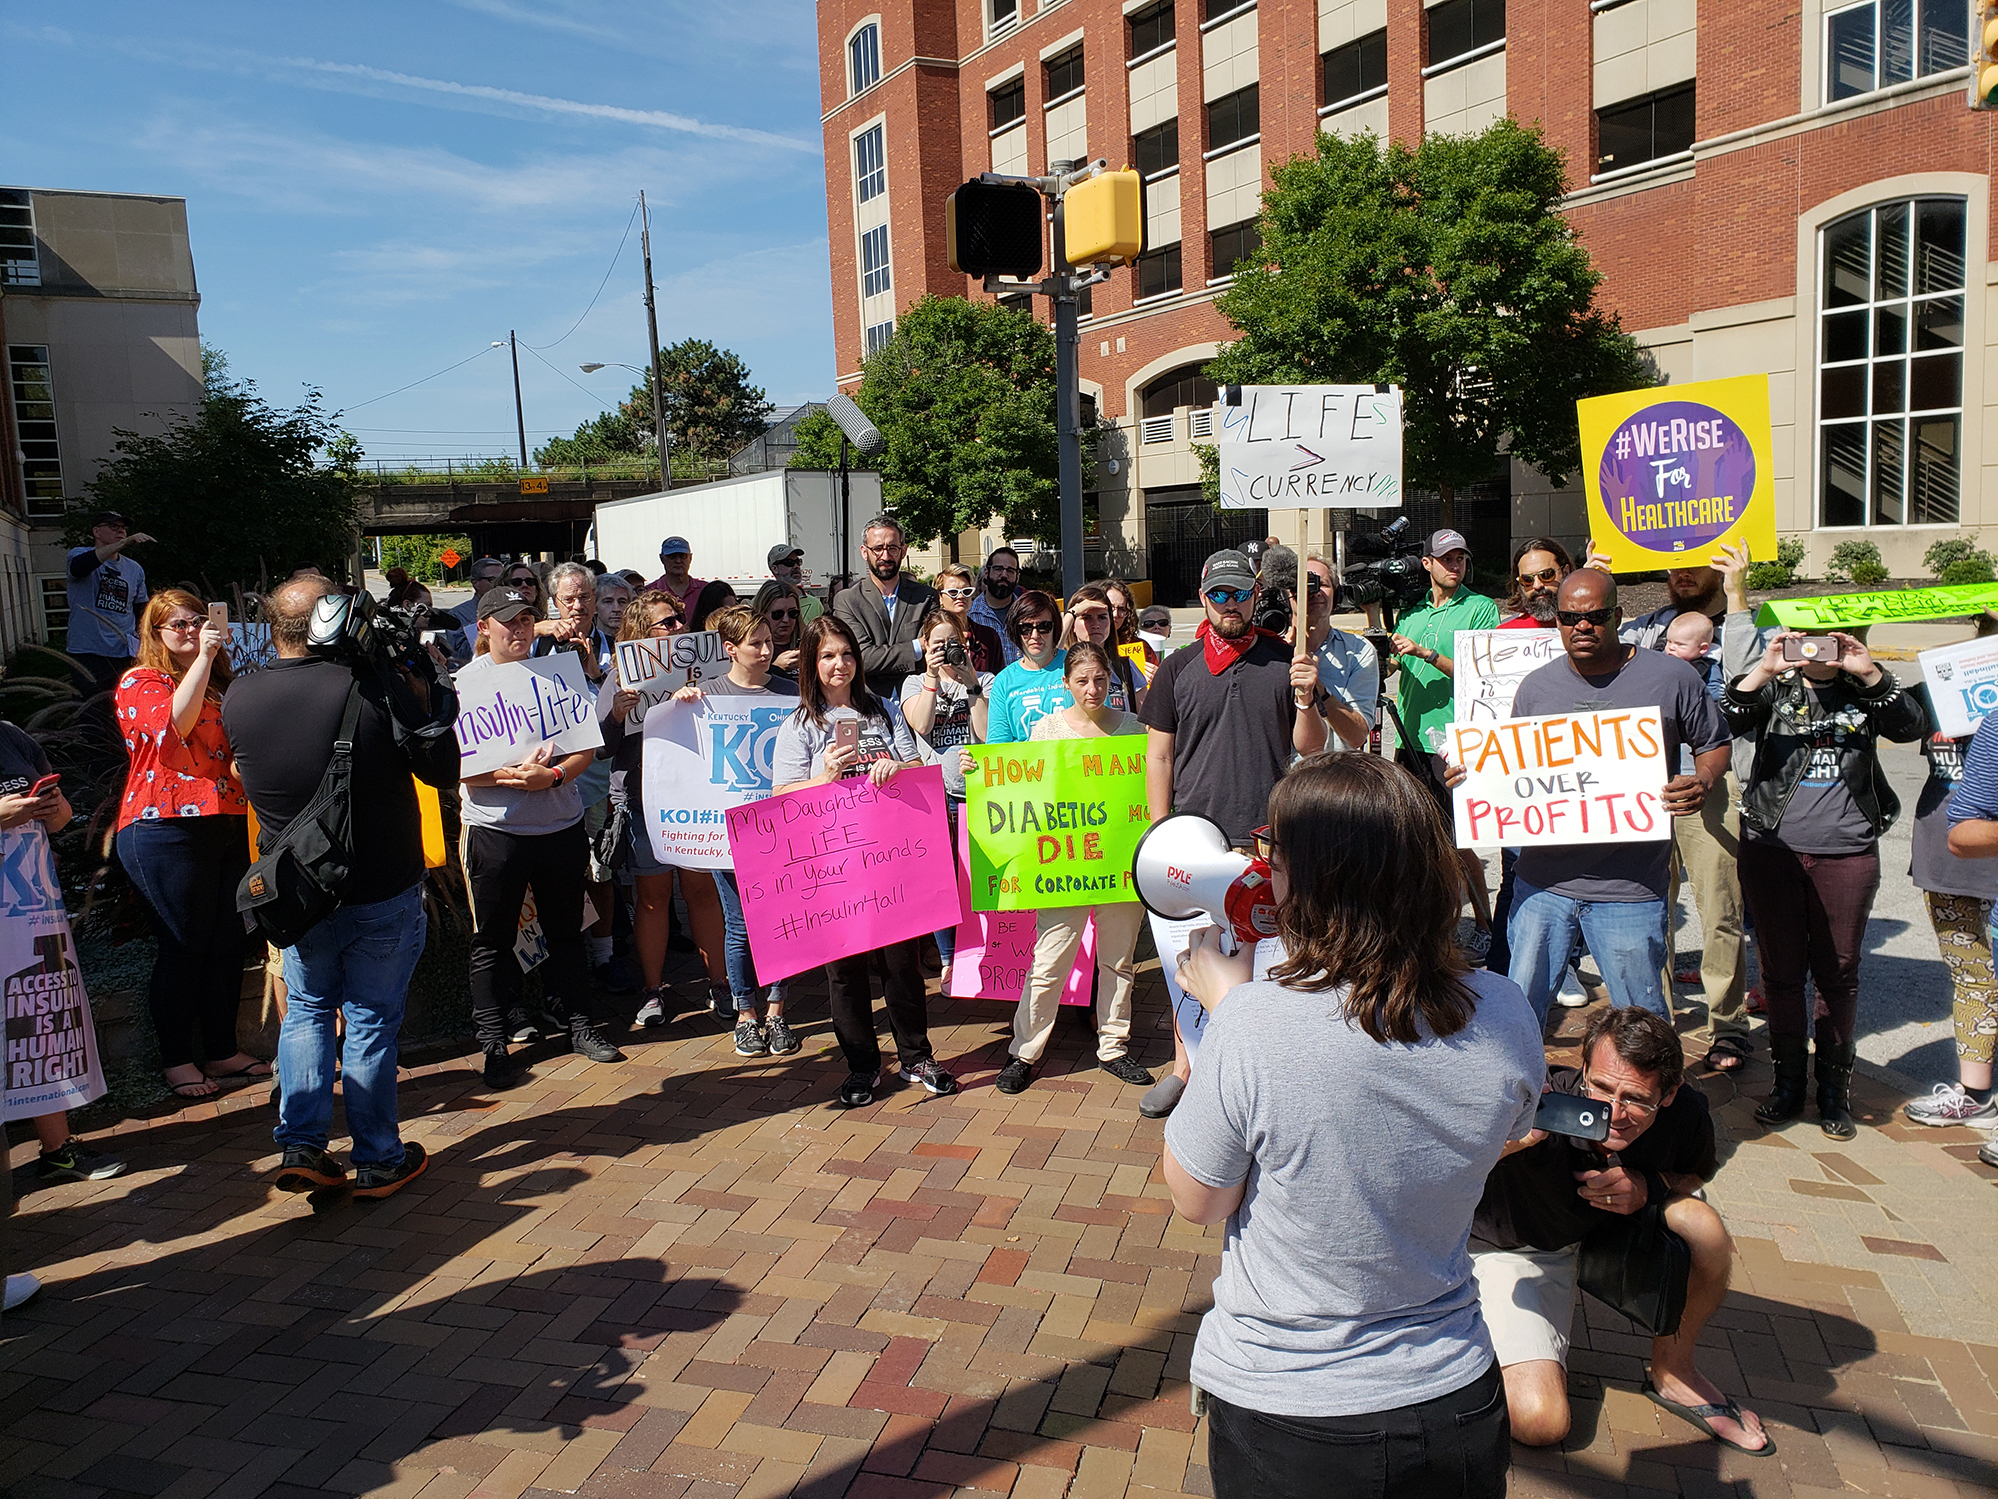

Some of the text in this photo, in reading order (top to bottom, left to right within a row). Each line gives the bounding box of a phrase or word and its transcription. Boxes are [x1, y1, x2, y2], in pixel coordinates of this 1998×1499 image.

[1246, 391, 1375, 443] LIFE
[521, 481, 531, 491] 13
[1249, 471, 1378, 500] CURRENCY
[1650, 457, 1692, 498] For
[619, 632, 732, 686] INSUL
[1120, 645, 1142, 656] YEAR
[686, 667, 702, 681] IS
[1008, 686, 1045, 698] Affordable
[769, 713, 791, 722] OHI
[932, 726, 969, 738] HUMAN
[932, 734, 970, 747] RIGHT
[983, 756, 1045, 788] HOW
[1514, 771, 1600, 798] OVER
[731, 808, 777, 854] My
[986, 801, 1108, 835] DIABETICS
[661, 830, 725, 843] Fighting for
[1036, 831, 1105, 866] DIE
[664, 844, 671, 852] in
[675, 845, 724, 858] Kentucky,
[743, 881, 765, 904] is
[774, 872, 793, 894] in
[862, 838, 928, 869] hands
[988, 875, 1022, 896] FOR
[1034, 873, 1117, 894] CORPORATE
[998, 922, 1017, 934] BE
[8, 970, 67, 996] ACCESS
[7, 986, 81, 1019] INSULIN
[36, 1011, 73, 1035] IS A
[8, 1027, 84, 1062] HUMAN
[12, 1049, 84, 1089] RIGHT
